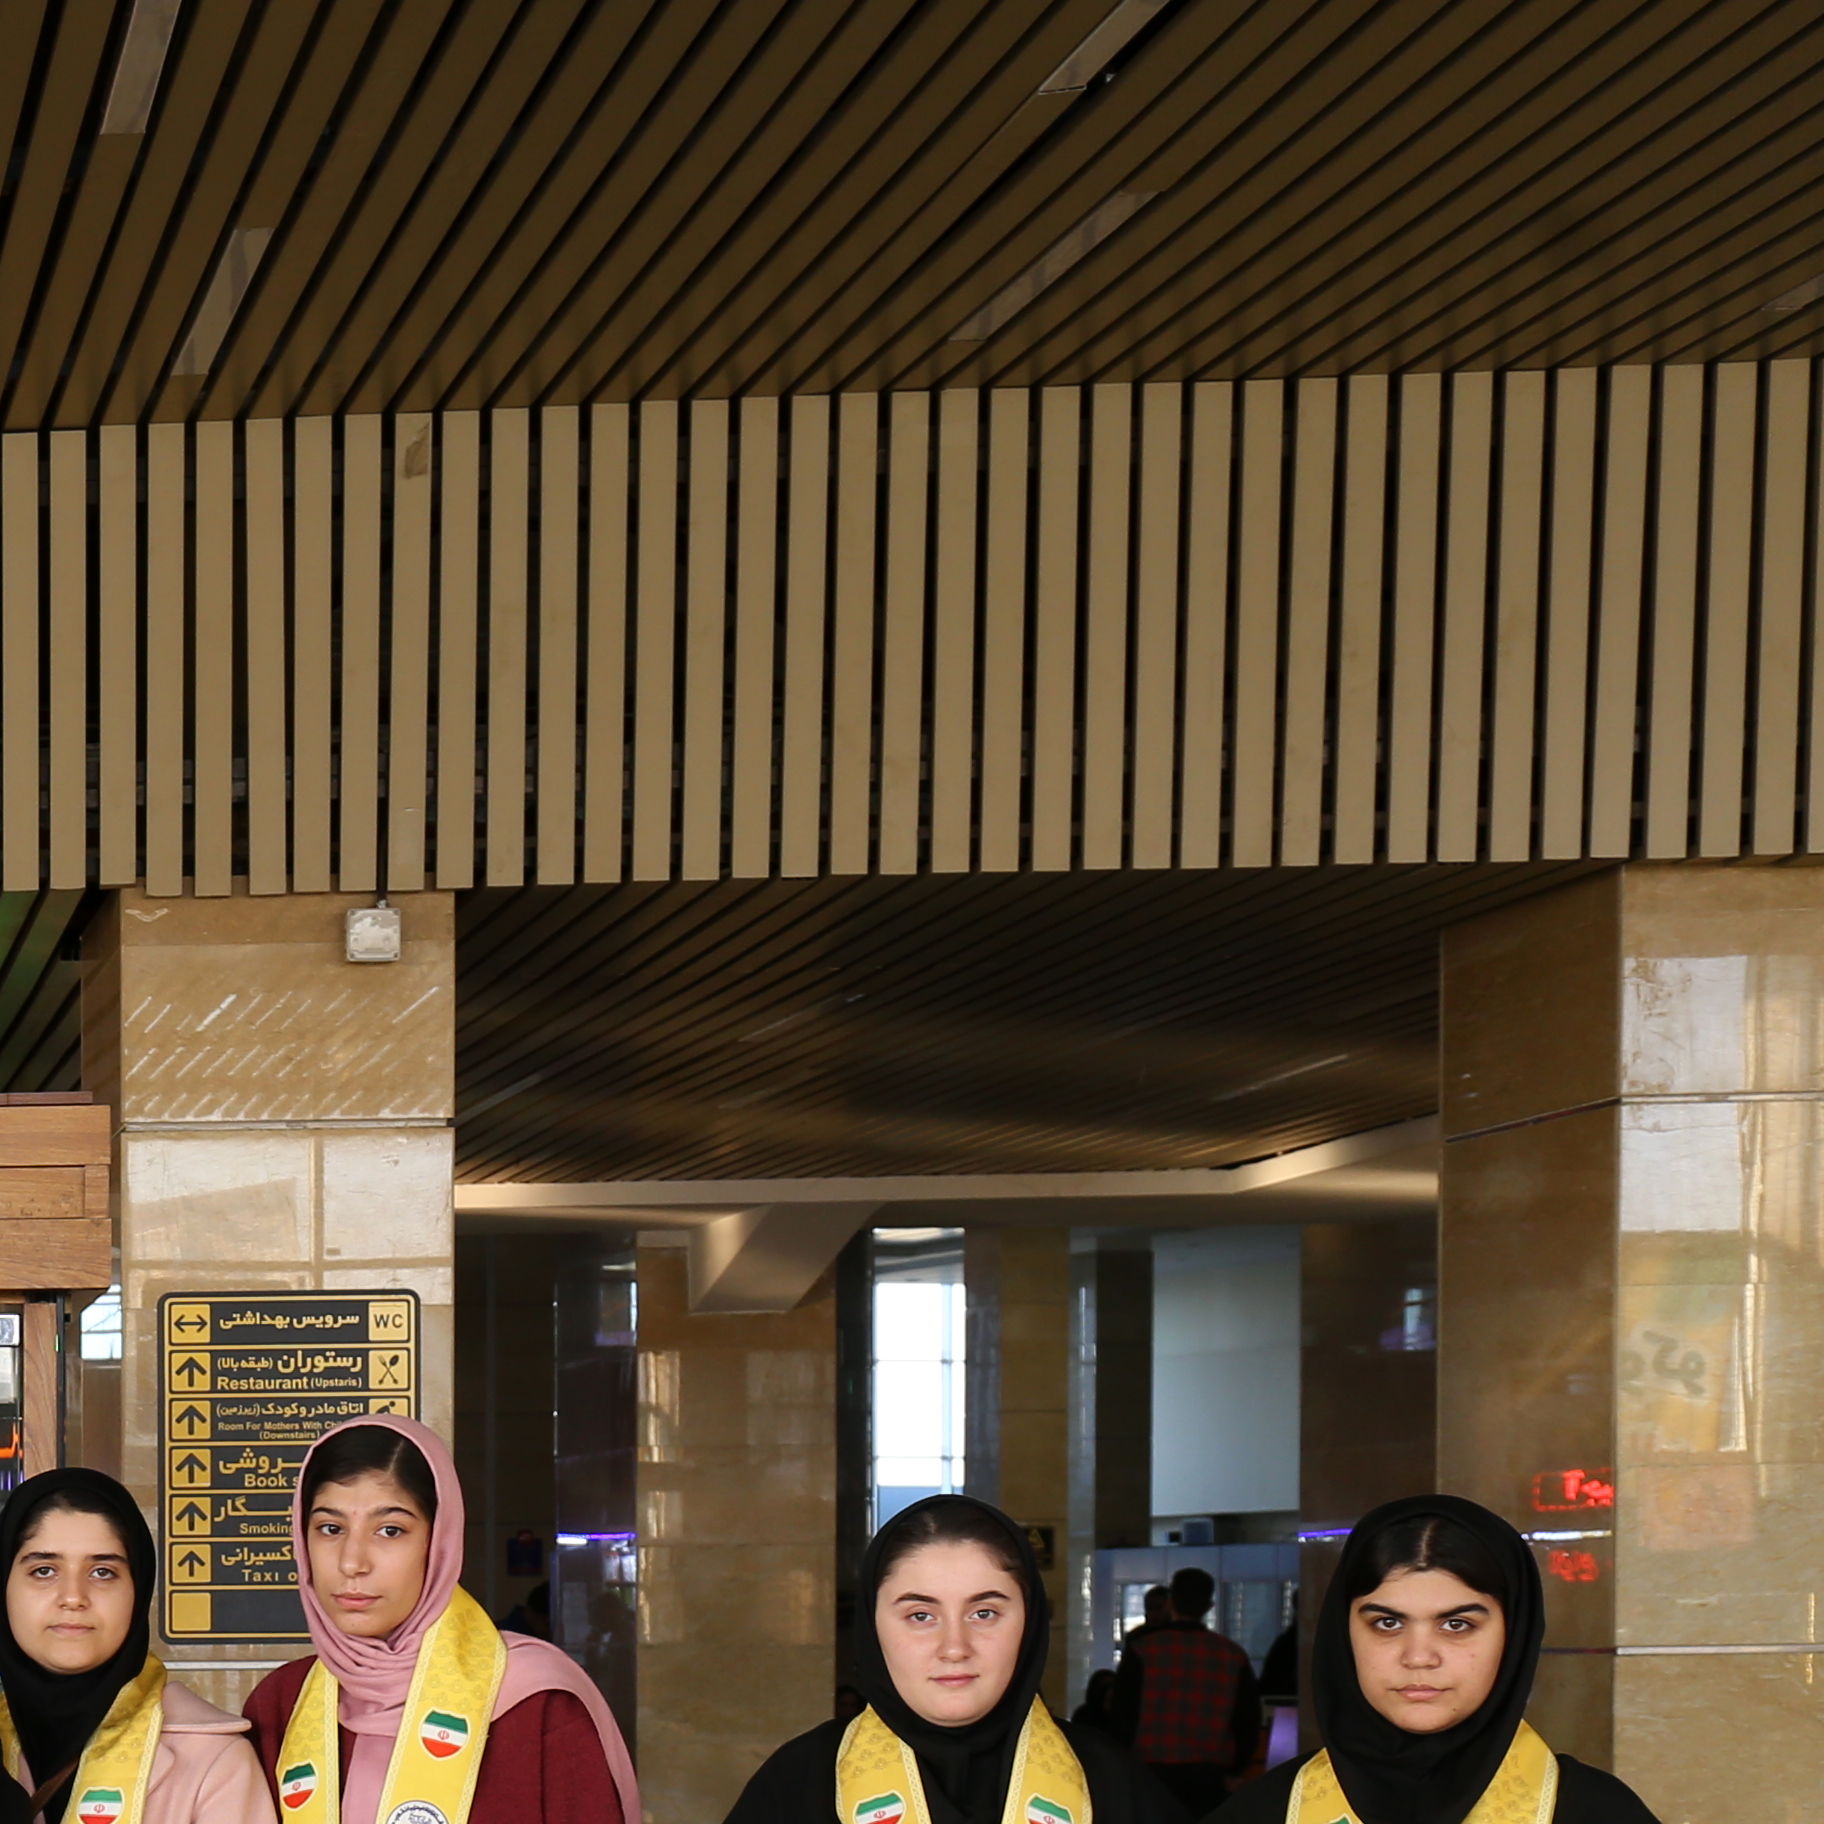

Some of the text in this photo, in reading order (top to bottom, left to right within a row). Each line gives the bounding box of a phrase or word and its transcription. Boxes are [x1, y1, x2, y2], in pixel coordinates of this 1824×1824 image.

[219, 1310, 360, 1330] سرویس بهداشتی
[373, 1313, 404, 1328] WC
[277, 1350, 362, 1373] رستوران
[217, 1377, 308, 1391] Restaurant
[261, 1402, 298, 1417] کودک
[299, 1405, 307, 1417] و
[307, 1402, 335, 1417] مادر
[337, 1401, 364, 1415] اتاق
[218, 1421, 244, 1431] Room
[246, 1421, 261, 1431] For
[263, 1420, 300, 1431] Mothers
[302, 1420, 322, 1430] With
[244, 1473, 288, 1488] Book
